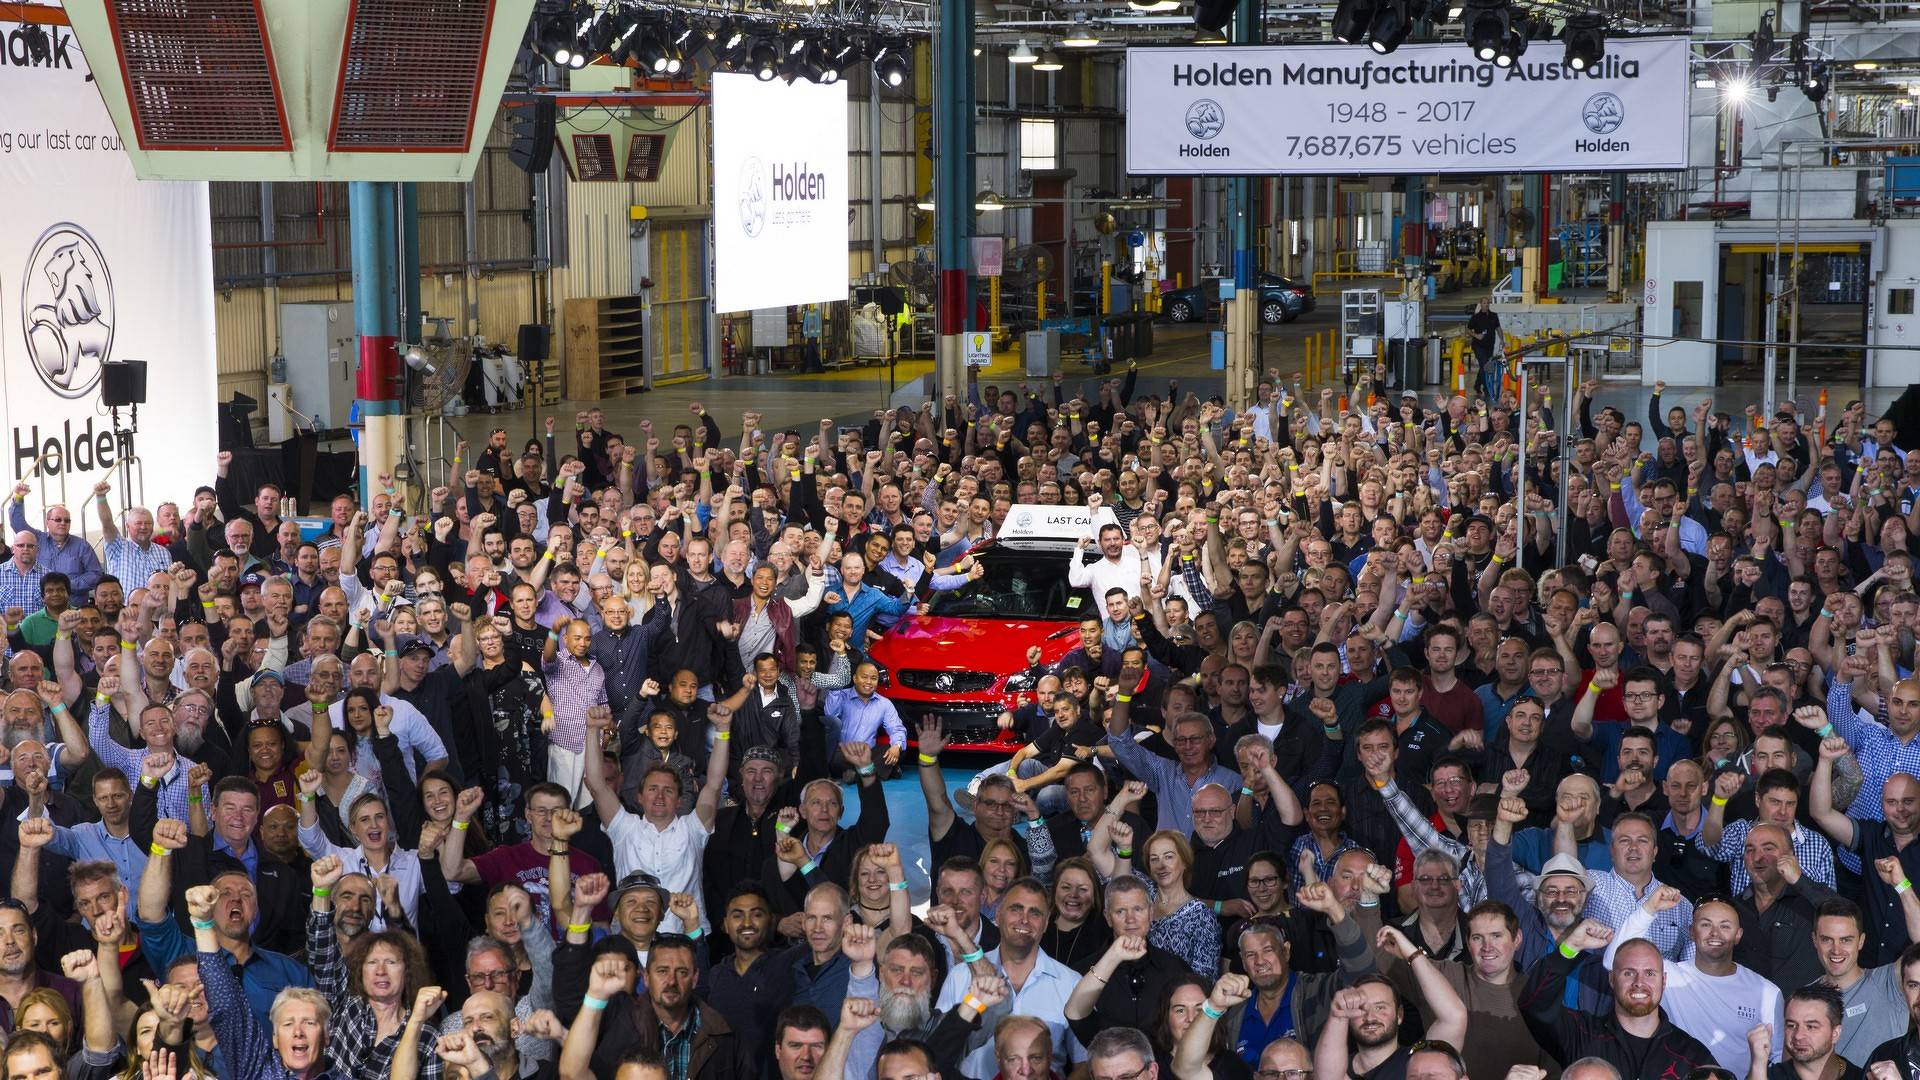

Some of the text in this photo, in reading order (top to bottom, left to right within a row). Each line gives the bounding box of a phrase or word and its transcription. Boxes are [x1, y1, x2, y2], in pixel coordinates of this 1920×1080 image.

[1173, 62, 1272, 86] Holden
[1282, 58, 1495, 90] Manufacturing
[1327, 102, 1387, 123] 1948
[1416, 100, 1476, 122] 2017
[17, 133, 41, 149] our
[46, 129, 70, 150] last
[75, 134, 97, 150] car
[1179, 144, 1230, 157] Holden
[1286, 132, 1517, 160] 7,687,675 vehicles
[1575, 139, 1630, 152] Holden
[772, 161, 825, 200] Holden
[13, 416, 135, 480] Holden
[1047, 516, 1072, 525] LAST
